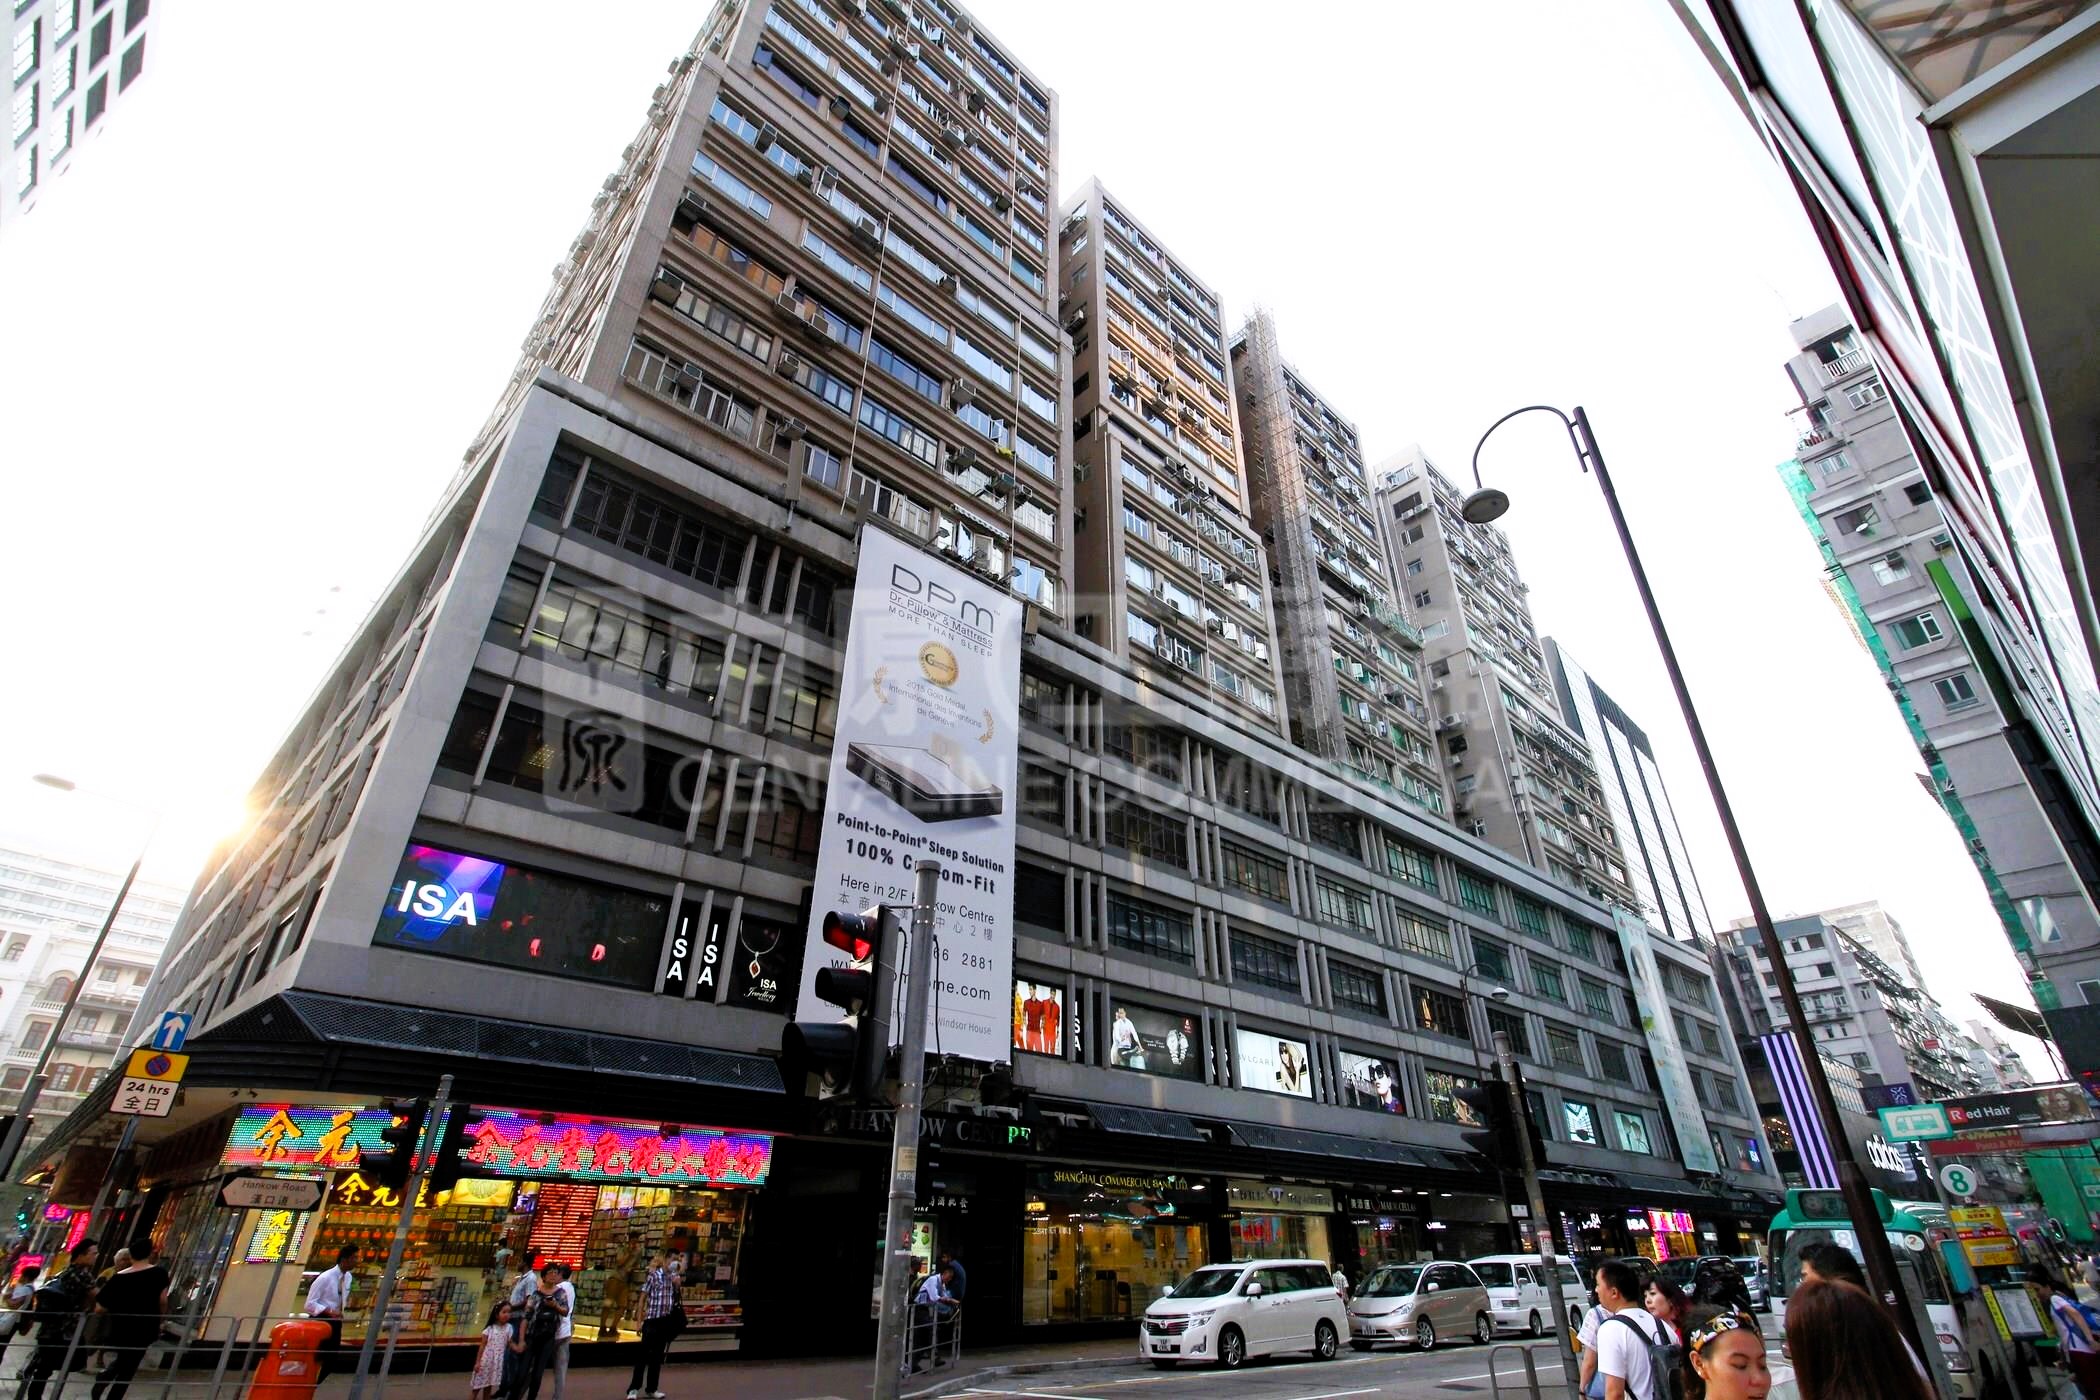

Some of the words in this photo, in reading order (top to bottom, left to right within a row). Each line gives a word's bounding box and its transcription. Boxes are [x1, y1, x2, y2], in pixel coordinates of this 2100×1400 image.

[889, 590, 904, 605] Dr.
[952, 621, 993, 648] Mattress
[888, 605, 921, 625] MORE
[927, 622, 956, 641] THAN
[960, 638, 993, 657] SLEEP
[846, 838, 895, 866] 100%
[902, 854, 996, 896] Com-Fit
[929, 840, 960, 861] Sleep
[961, 850, 1005, 874] Solution
[397, 880, 478, 926] ISA
[839, 873, 871, 893] Here
[873, 880, 885, 896] in
[887, 886, 908, 901] 2/F
[958, 904, 995, 925] Centre
[666, 917, 689, 981] ISA
[697, 923, 719, 987] ISA
[961, 952, 993, 972] 2881
[743, 986, 777, 1003] Jewellery
[760, 978, 777, 991] ISA
[968, 1024, 992, 1036] House
[1238, 1052, 1274, 1067] VLGARI
[125, 1081, 145, 1093] 24
[148, 1085, 171, 1096] hrs
[122, 1095, 161, 1112] 全日
[1985, 1104, 2012, 1118] Hair
[849, 1110, 947, 1138] HANOW
[1866, 1133, 1906, 1174] adidas
[241, 1180, 279, 1190] Hankow
[282, 1182, 307, 1193] Road
[1054, 1170, 1097, 1185] SHANGHAI
[1100, 1175, 1151, 1188] COMMERCIAL
[1949, 1170, 1970, 1194] 8
[1625, 1218, 1650, 1231] ISA
